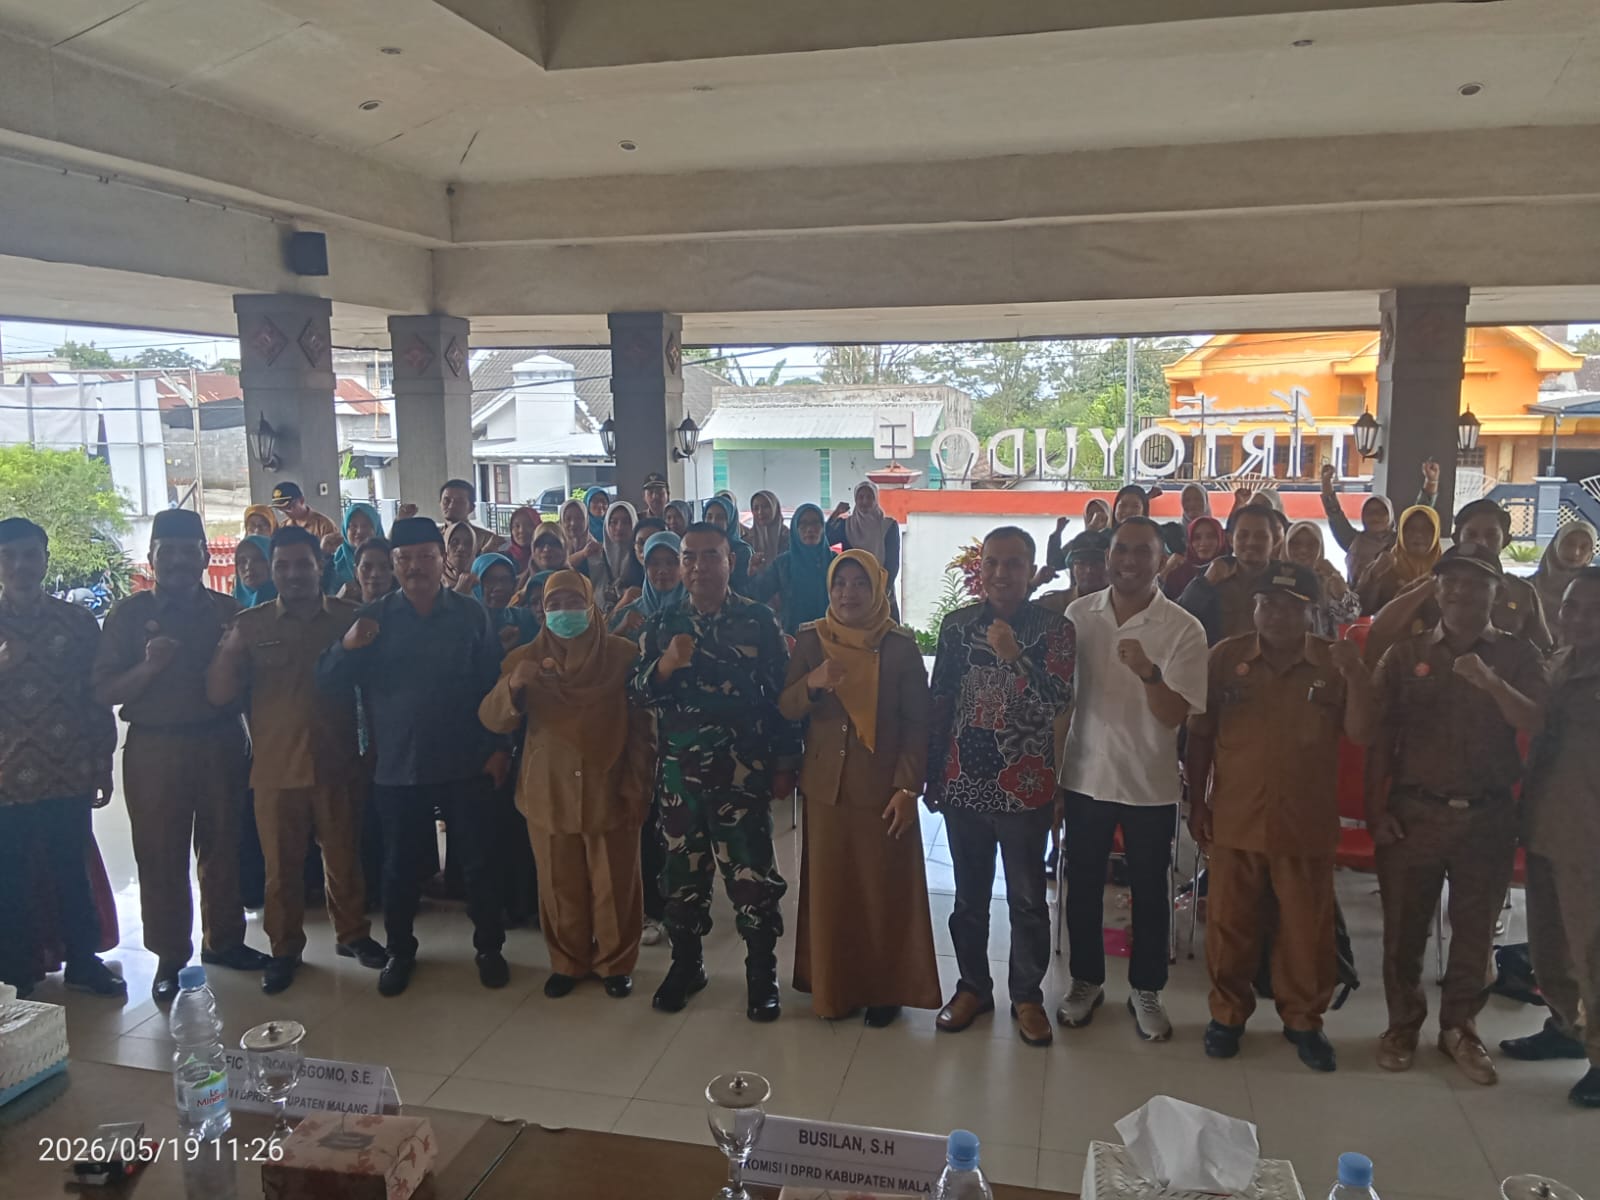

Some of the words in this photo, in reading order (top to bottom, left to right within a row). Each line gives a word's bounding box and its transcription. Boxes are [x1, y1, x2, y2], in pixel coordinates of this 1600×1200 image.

[226, 1055, 243, 1070] FIC
[351, 1069, 374, 1085] S.E.
[285, 1095, 325, 1110] UPATEN
[326, 1100, 368, 1114] MALANG
[799, 1129, 866, 1155] BUSILAN,
[870, 1139, 895, 1156] S.H
[791, 1164, 822, 1180] DPRD
[824, 1168, 895, 1190] KABUPATEN
[898, 1179, 932, 1194] MALA
